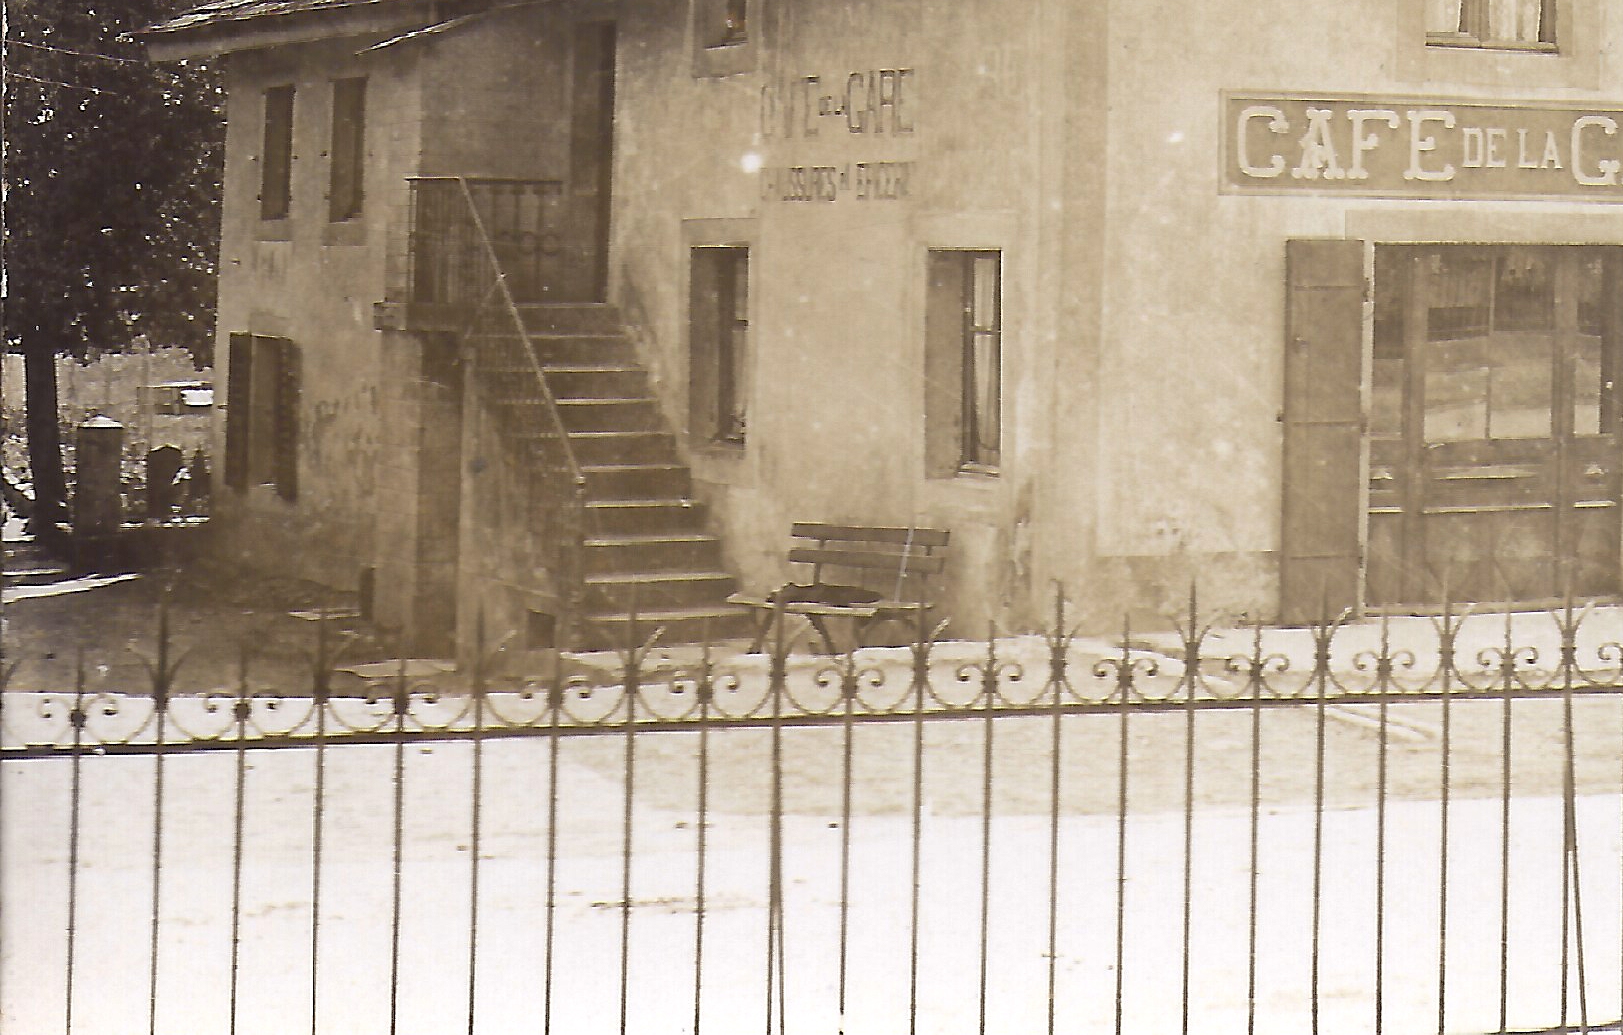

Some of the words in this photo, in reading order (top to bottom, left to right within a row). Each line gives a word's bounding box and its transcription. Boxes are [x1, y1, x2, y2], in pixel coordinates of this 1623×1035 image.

[847, 68, 915, 138] GARE
[1236, 105, 1456, 181] CAFE
[1461, 127, 1507, 169] DE
[1516, 128, 1564, 170] LA
